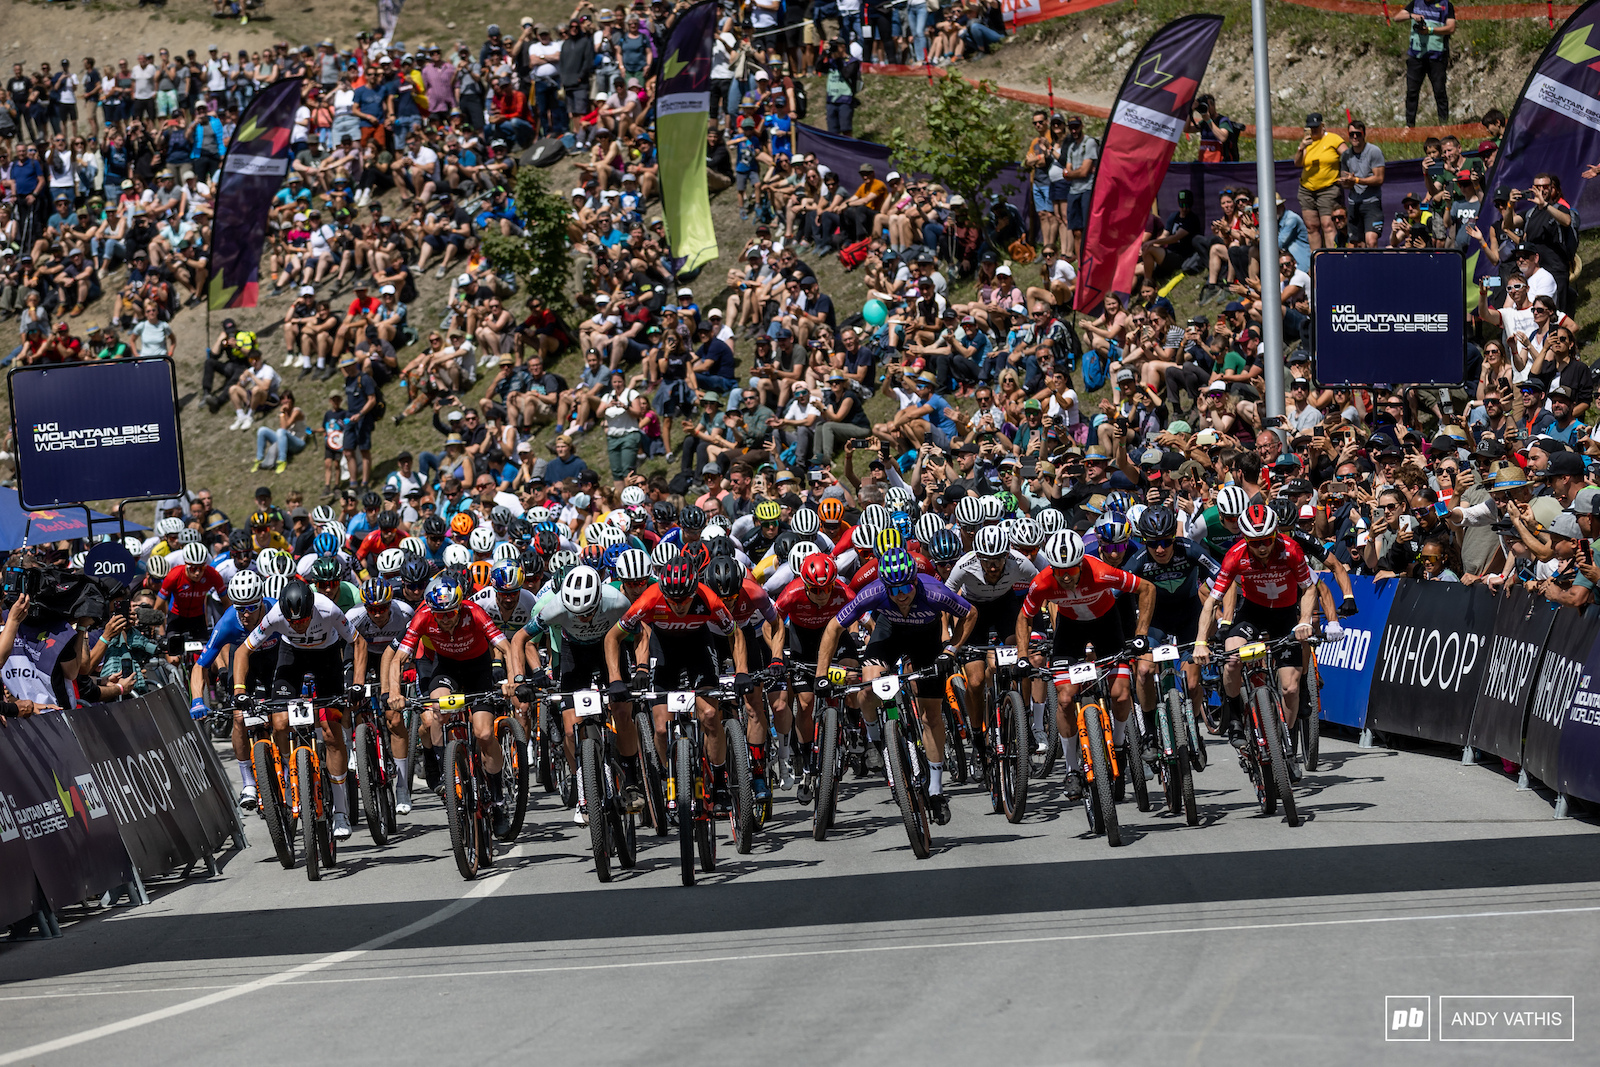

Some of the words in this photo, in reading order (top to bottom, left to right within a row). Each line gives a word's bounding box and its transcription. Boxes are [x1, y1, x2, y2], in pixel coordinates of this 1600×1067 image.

[1538, 93, 1571, 111] WORLD
[1540, 88, 1584, 111] MOUNTAIN
[1457, 209, 1476, 219] FOX
[1335, 304, 1356, 314] UCI
[1331, 313, 1411, 323] MOUNTAIN
[1413, 313, 1449, 323] BIKE
[1331, 323, 1391, 333] WORLD
[1393, 323, 1449, 333] SERIES
[34, 427, 119, 443] MOUNTAIN
[121, 423, 160, 436] BIKE
[38, 422, 59, 433] UCI
[35, 438, 98, 452] WORLD
[101, 433, 160, 447] SERIES
[35, 521, 64, 533] Red
[63, 519, 87, 531] Bull
[94, 561, 126, 575] 20m
[1160, 647, 1170, 656] 2
[1249, 647, 1256, 657] 7
[1073, 665, 1091, 675] 24
[828, 671, 841, 681] 10
[881, 681, 891, 692] 5
[582, 696, 592, 708] 9
[676, 694, 686, 704] 4
[1569, 706, 1595, 725] WORLD
[82, 782, 104, 812] UCI
[14, 803, 45, 825] OUNTAIN
[44, 799, 62, 817] BIKE
[21, 821, 43, 840] ORLD
[42, 814, 69, 836] SERIES
